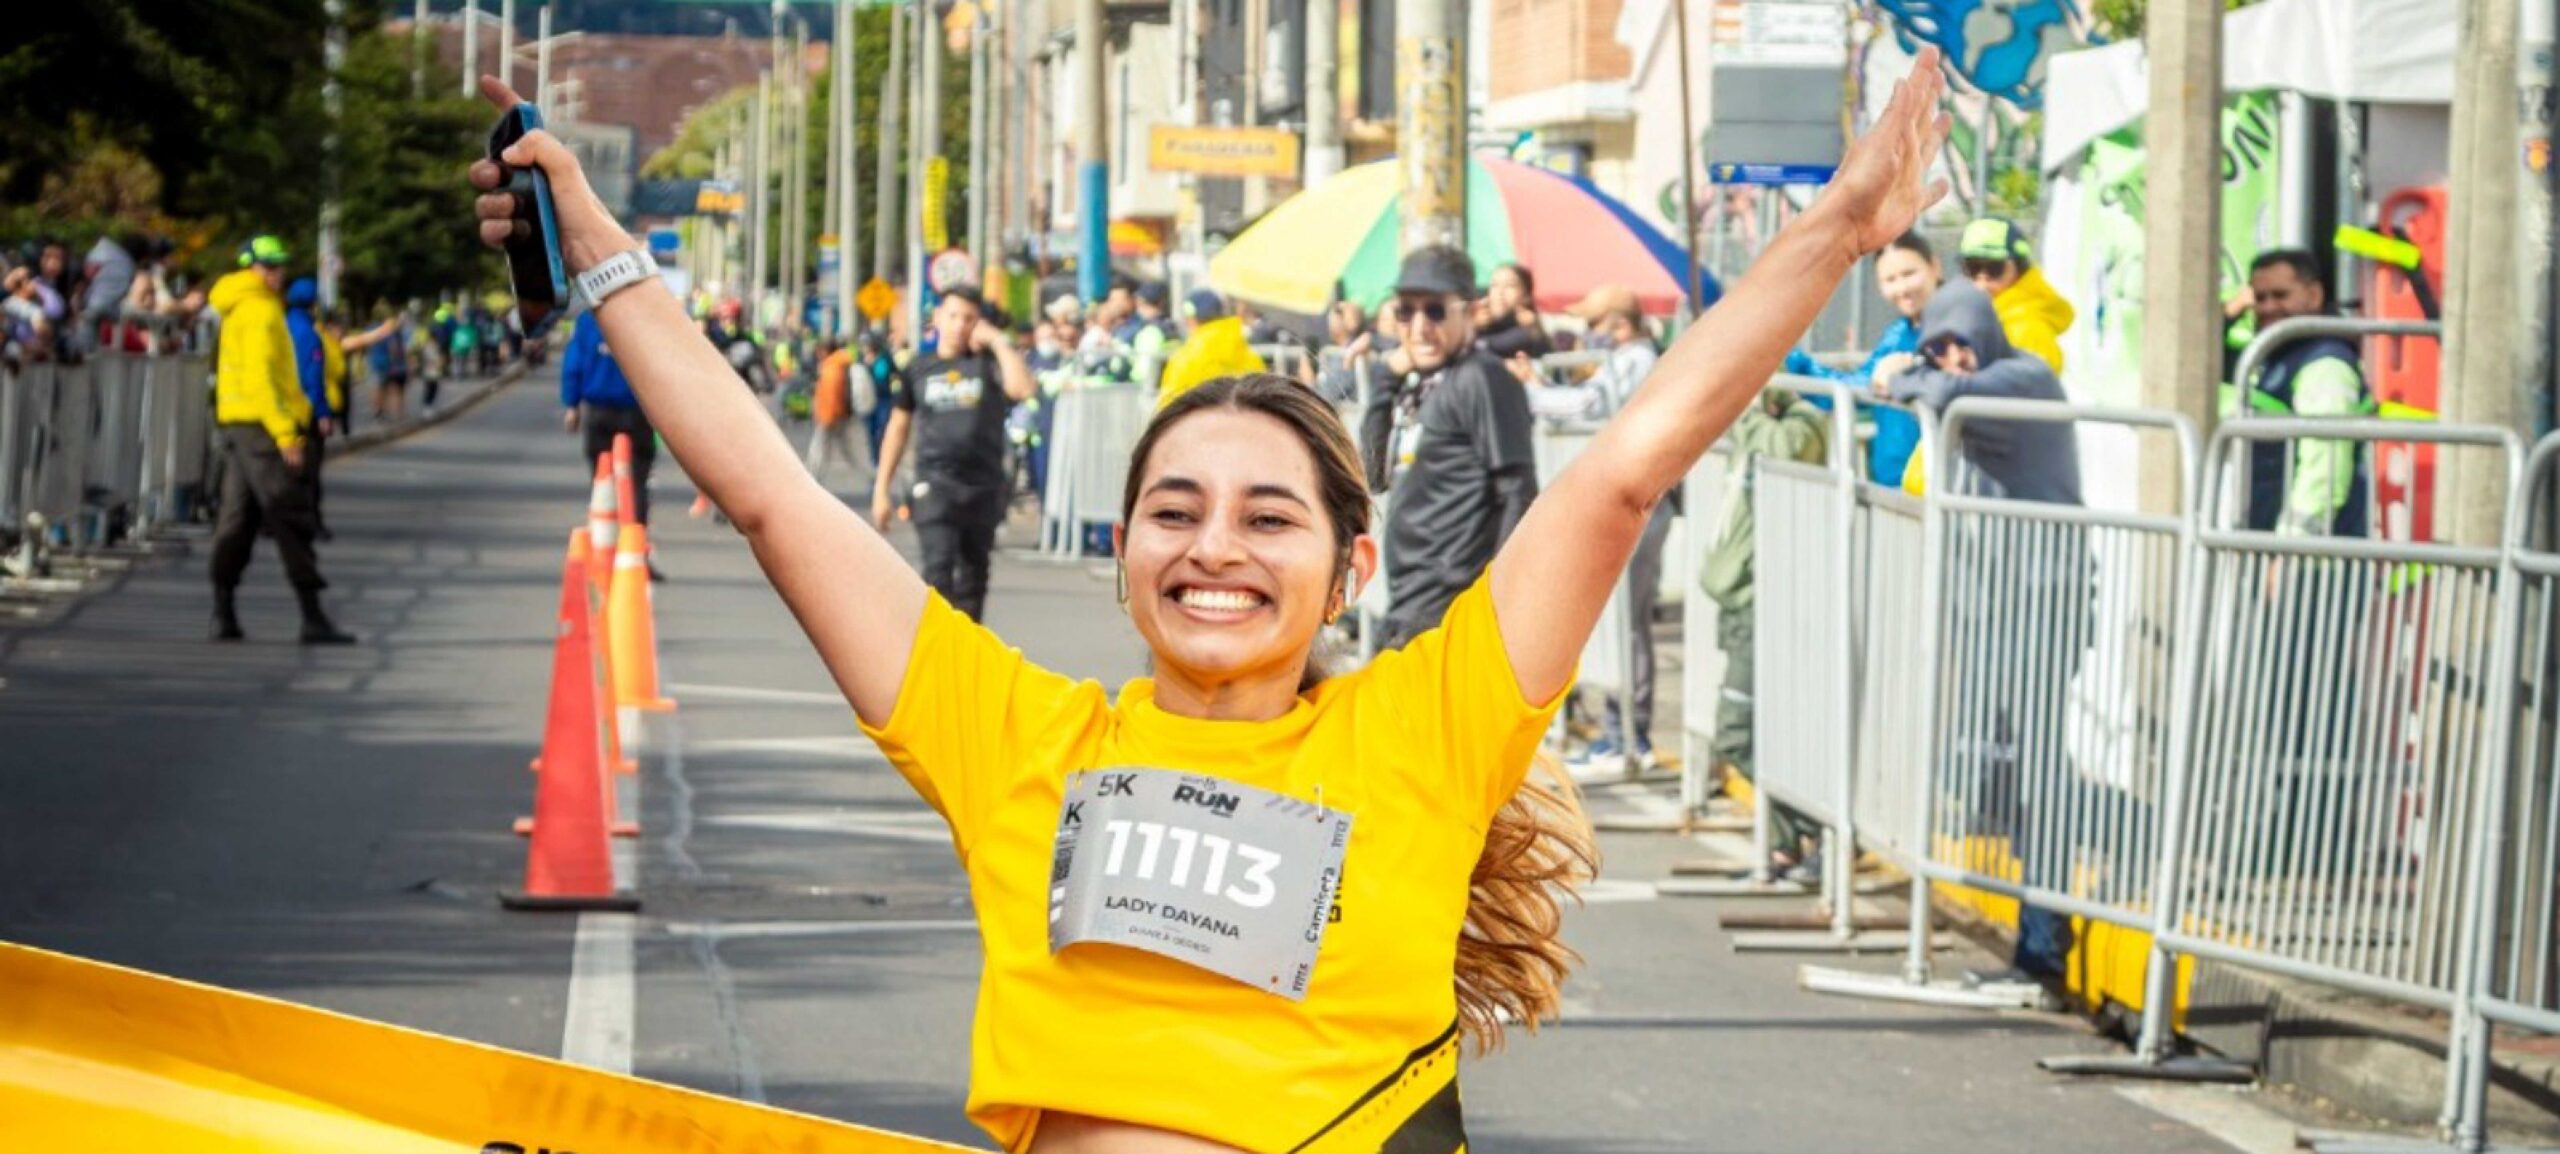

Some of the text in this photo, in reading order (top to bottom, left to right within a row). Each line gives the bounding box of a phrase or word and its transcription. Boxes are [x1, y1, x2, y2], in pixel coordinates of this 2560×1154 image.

[1097, 774, 1137, 797] 5K
[1173, 784, 1241, 812] RUN
[1105, 819, 1282, 908] 11113
[1105, 895, 1157, 914] LADY
[1161, 905, 1239, 939] DAYANA
[1305, 866, 1335, 943] Camiseta
